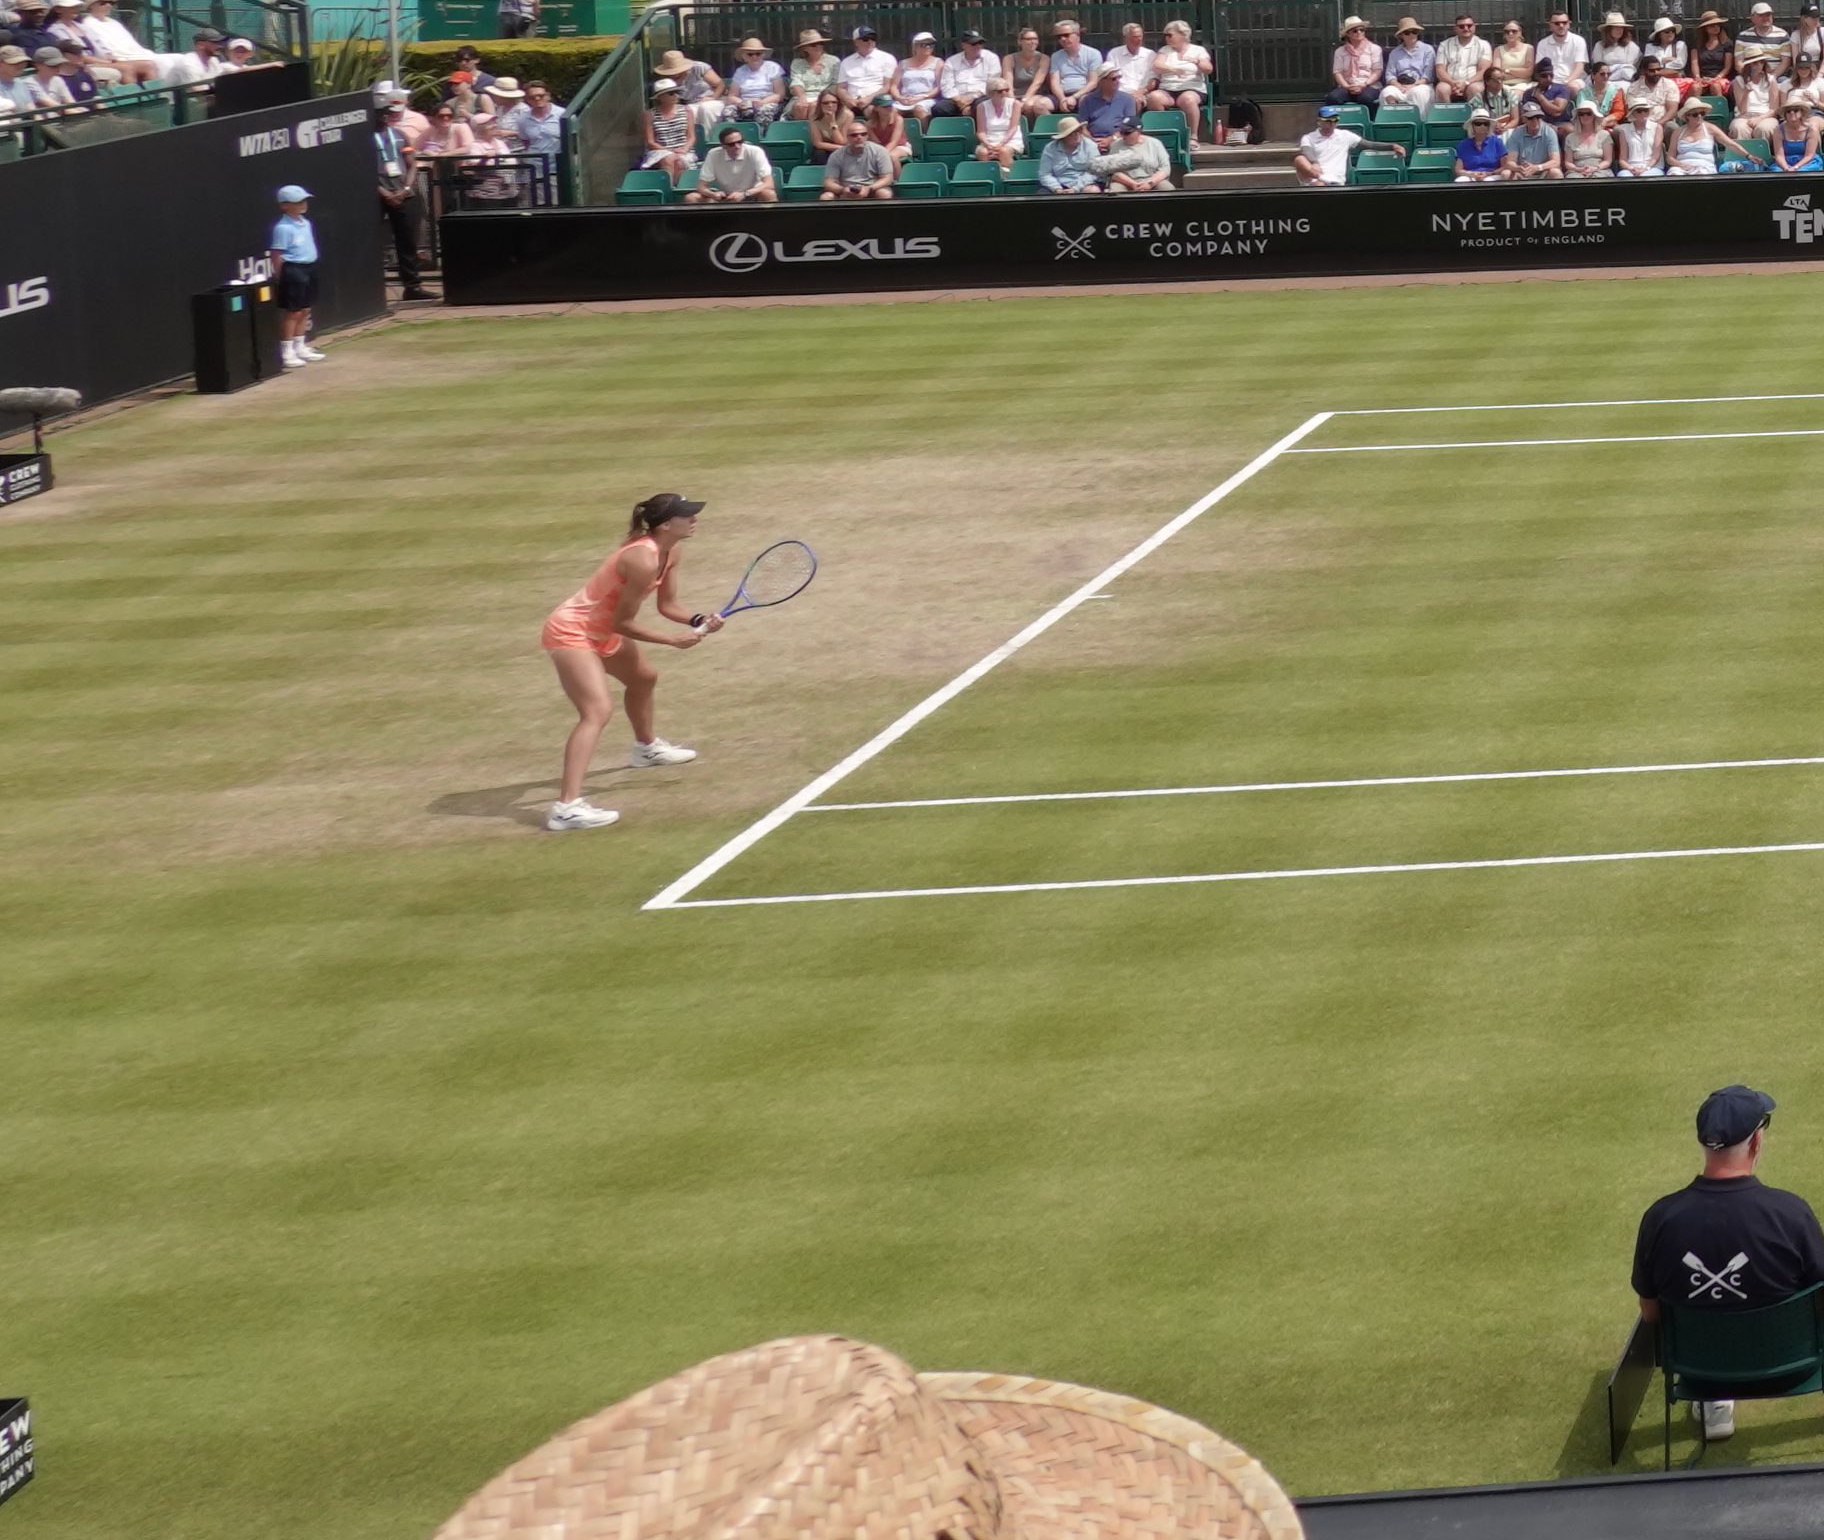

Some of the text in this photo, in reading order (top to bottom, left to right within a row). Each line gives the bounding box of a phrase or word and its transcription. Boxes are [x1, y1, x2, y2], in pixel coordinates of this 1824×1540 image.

[240, 131, 273, 157] WTA
[1105, 218, 1311, 239] CREW CLOTHING
[1432, 207, 1627, 233] NYETIMBER
[773, 237, 941, 261] LEXUS
[1149, 239, 1269, 257] COMPANY
[1460, 236, 1522, 248] PRODUCT
[1544, 234, 1606, 245] ENGLAND
[9, 462, 40, 483] CREW
[1690, 1272, 1742, 1299] C C C
[0, 1409, 31, 1456] EW
[0, 1456, 34, 1496] PANY
